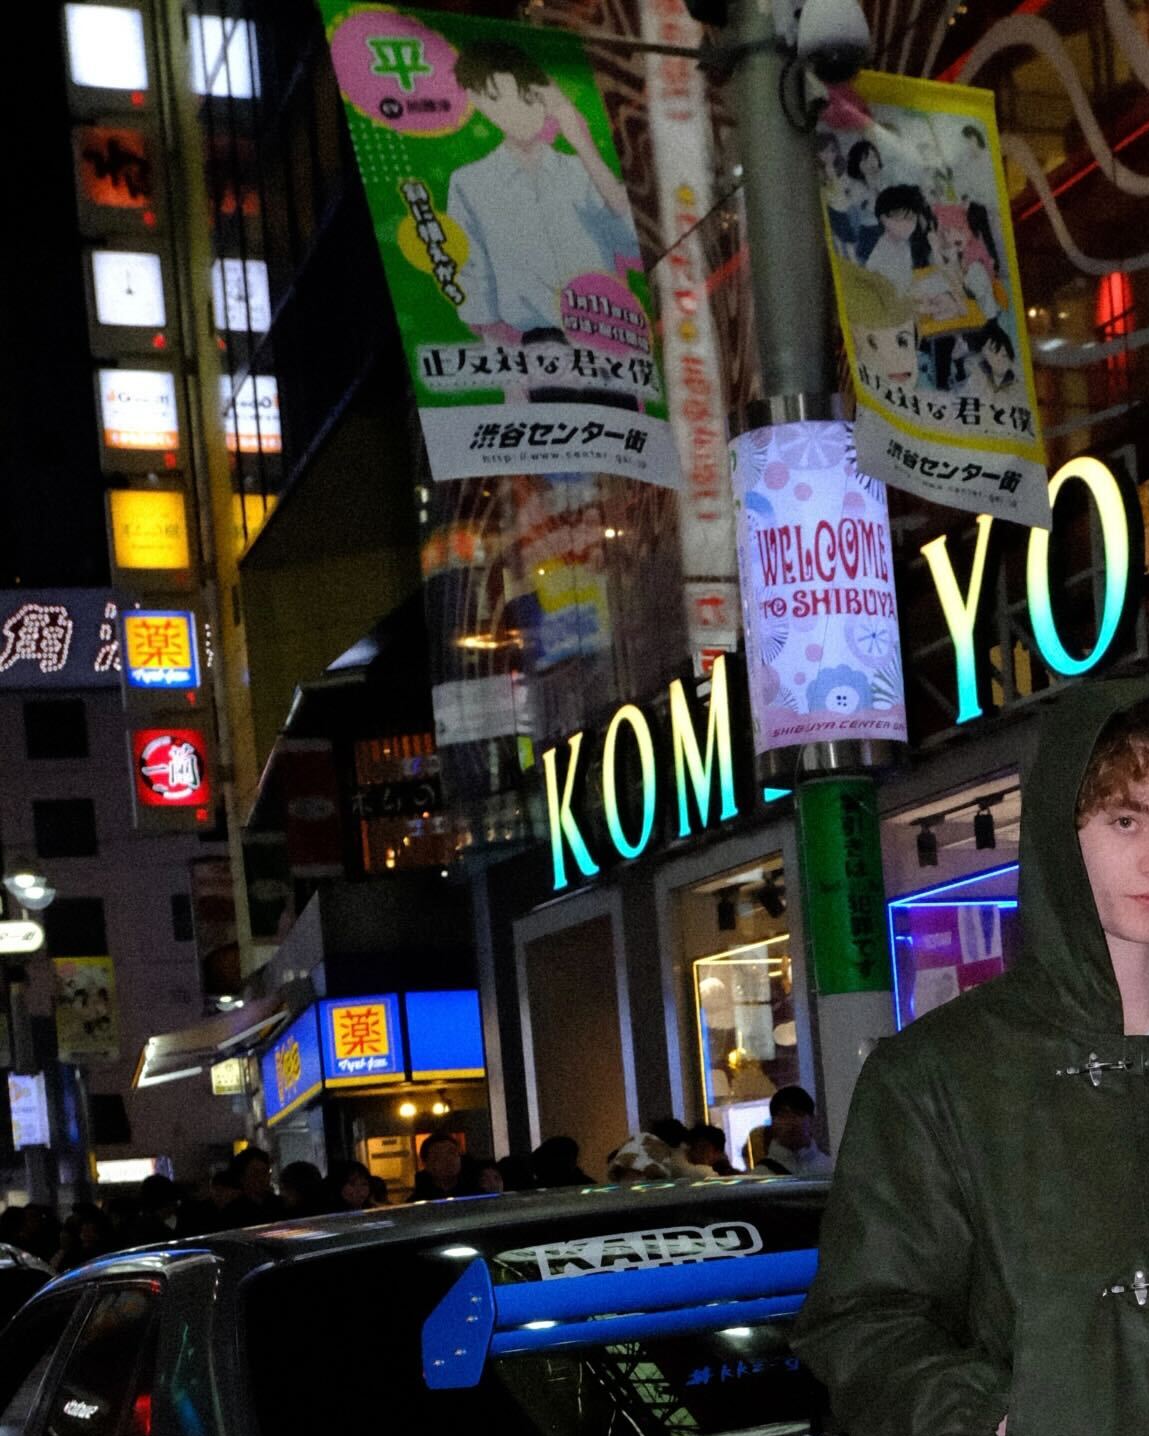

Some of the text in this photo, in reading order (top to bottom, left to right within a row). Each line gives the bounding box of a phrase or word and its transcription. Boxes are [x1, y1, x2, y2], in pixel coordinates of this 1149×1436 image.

[366, 36, 434, 94] 平
[470, 421, 648, 453] 渋谷センター街
[886, 439, 1023, 493] 渋谷センター街
[756, 518, 888, 586] WELCOME
[792, 588, 895, 618] SHIBUYA
[134, 620, 182, 666] 薬
[542, 456, 1130, 892] KOMYO
[771, 721, 835, 738] SHIBUYA
[839, 719, 890, 730] CENTER
[340, 1007, 383, 1056] 薬
[537, 1222, 762, 1279] KAIDO
